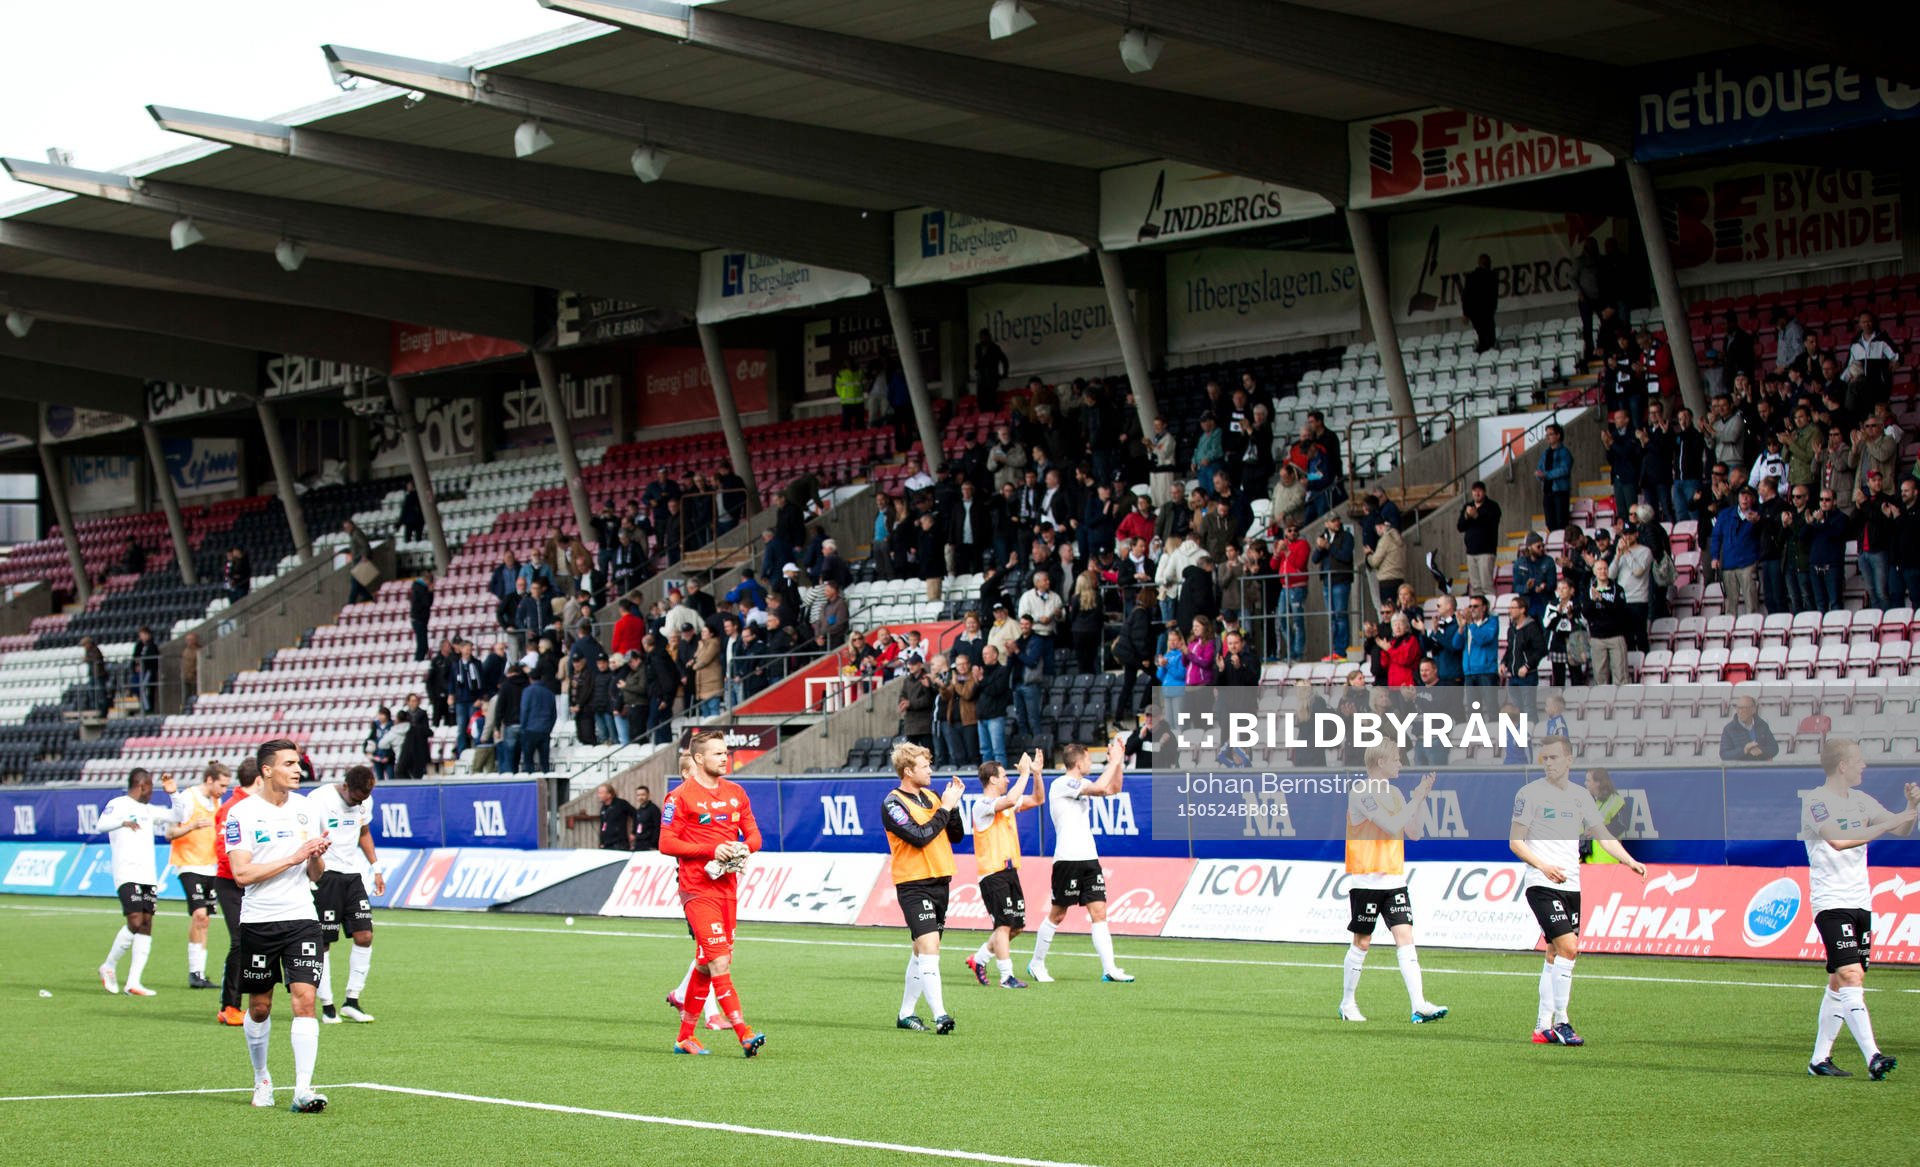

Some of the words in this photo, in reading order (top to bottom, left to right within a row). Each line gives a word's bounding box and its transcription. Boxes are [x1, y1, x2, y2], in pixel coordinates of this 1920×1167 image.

[1639, 63, 1864, 136] nethouse
[1475, 137, 1593, 186] HANDEL
[646, 370, 681, 396] Energi
[381, 803, 413, 838] NA
[473, 800, 507, 837] NA
[821, 795, 864, 836] NA
[1088, 791, 1139, 836] NA
[1242, 789, 1297, 838] NA
[1407, 789, 1470, 838] NA
[1198, 864, 1293, 897] ICON
[1190, 903, 1274, 916] PHOTOGRAPHY
[1432, 909, 1532, 924] PHOTOGRAPHY
[1583, 892, 1727, 942] NEMAX
